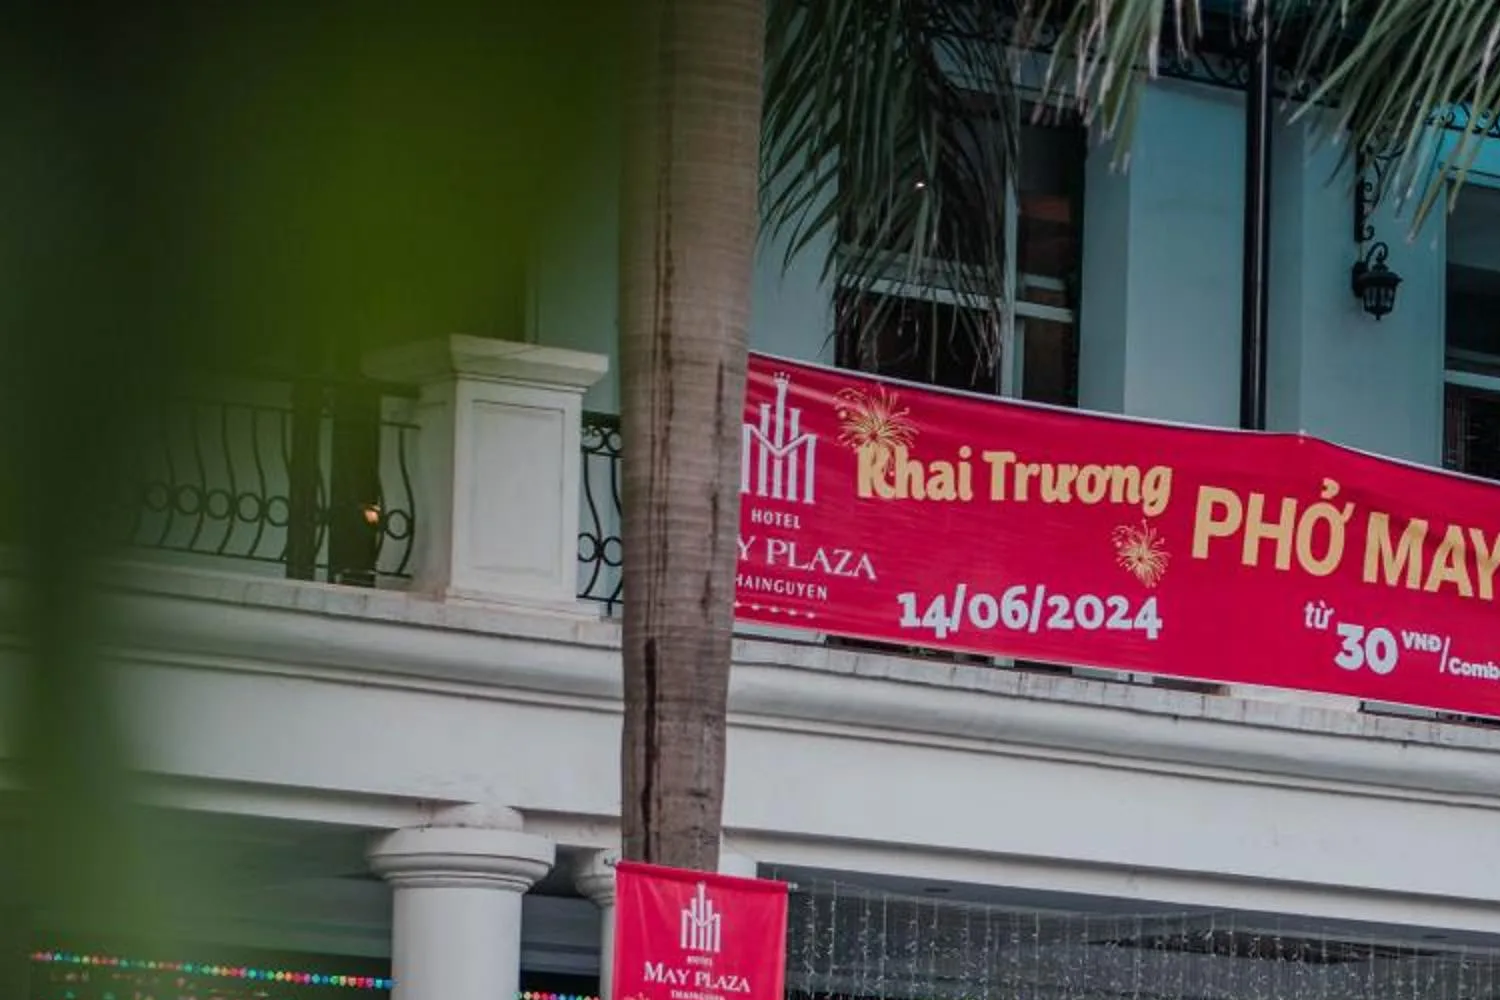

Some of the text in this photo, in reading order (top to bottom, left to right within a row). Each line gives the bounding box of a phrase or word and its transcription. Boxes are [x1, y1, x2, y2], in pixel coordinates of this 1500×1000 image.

[858, 444, 1173, 518] Khai Trương
[751, 508, 801, 529] HOTEL
[1191, 477, 1356, 578] PHỞ
[766, 537, 877, 581] PLAZA
[735, 573, 828, 600] HAINGUYEN
[897, 584, 1163, 639] 14/06/2024
[1304, 602, 1334, 630] từ
[1334, 623, 1399, 675] 30
[643, 960, 690, 985] MAY
[694, 970, 752, 993] PLAZA
